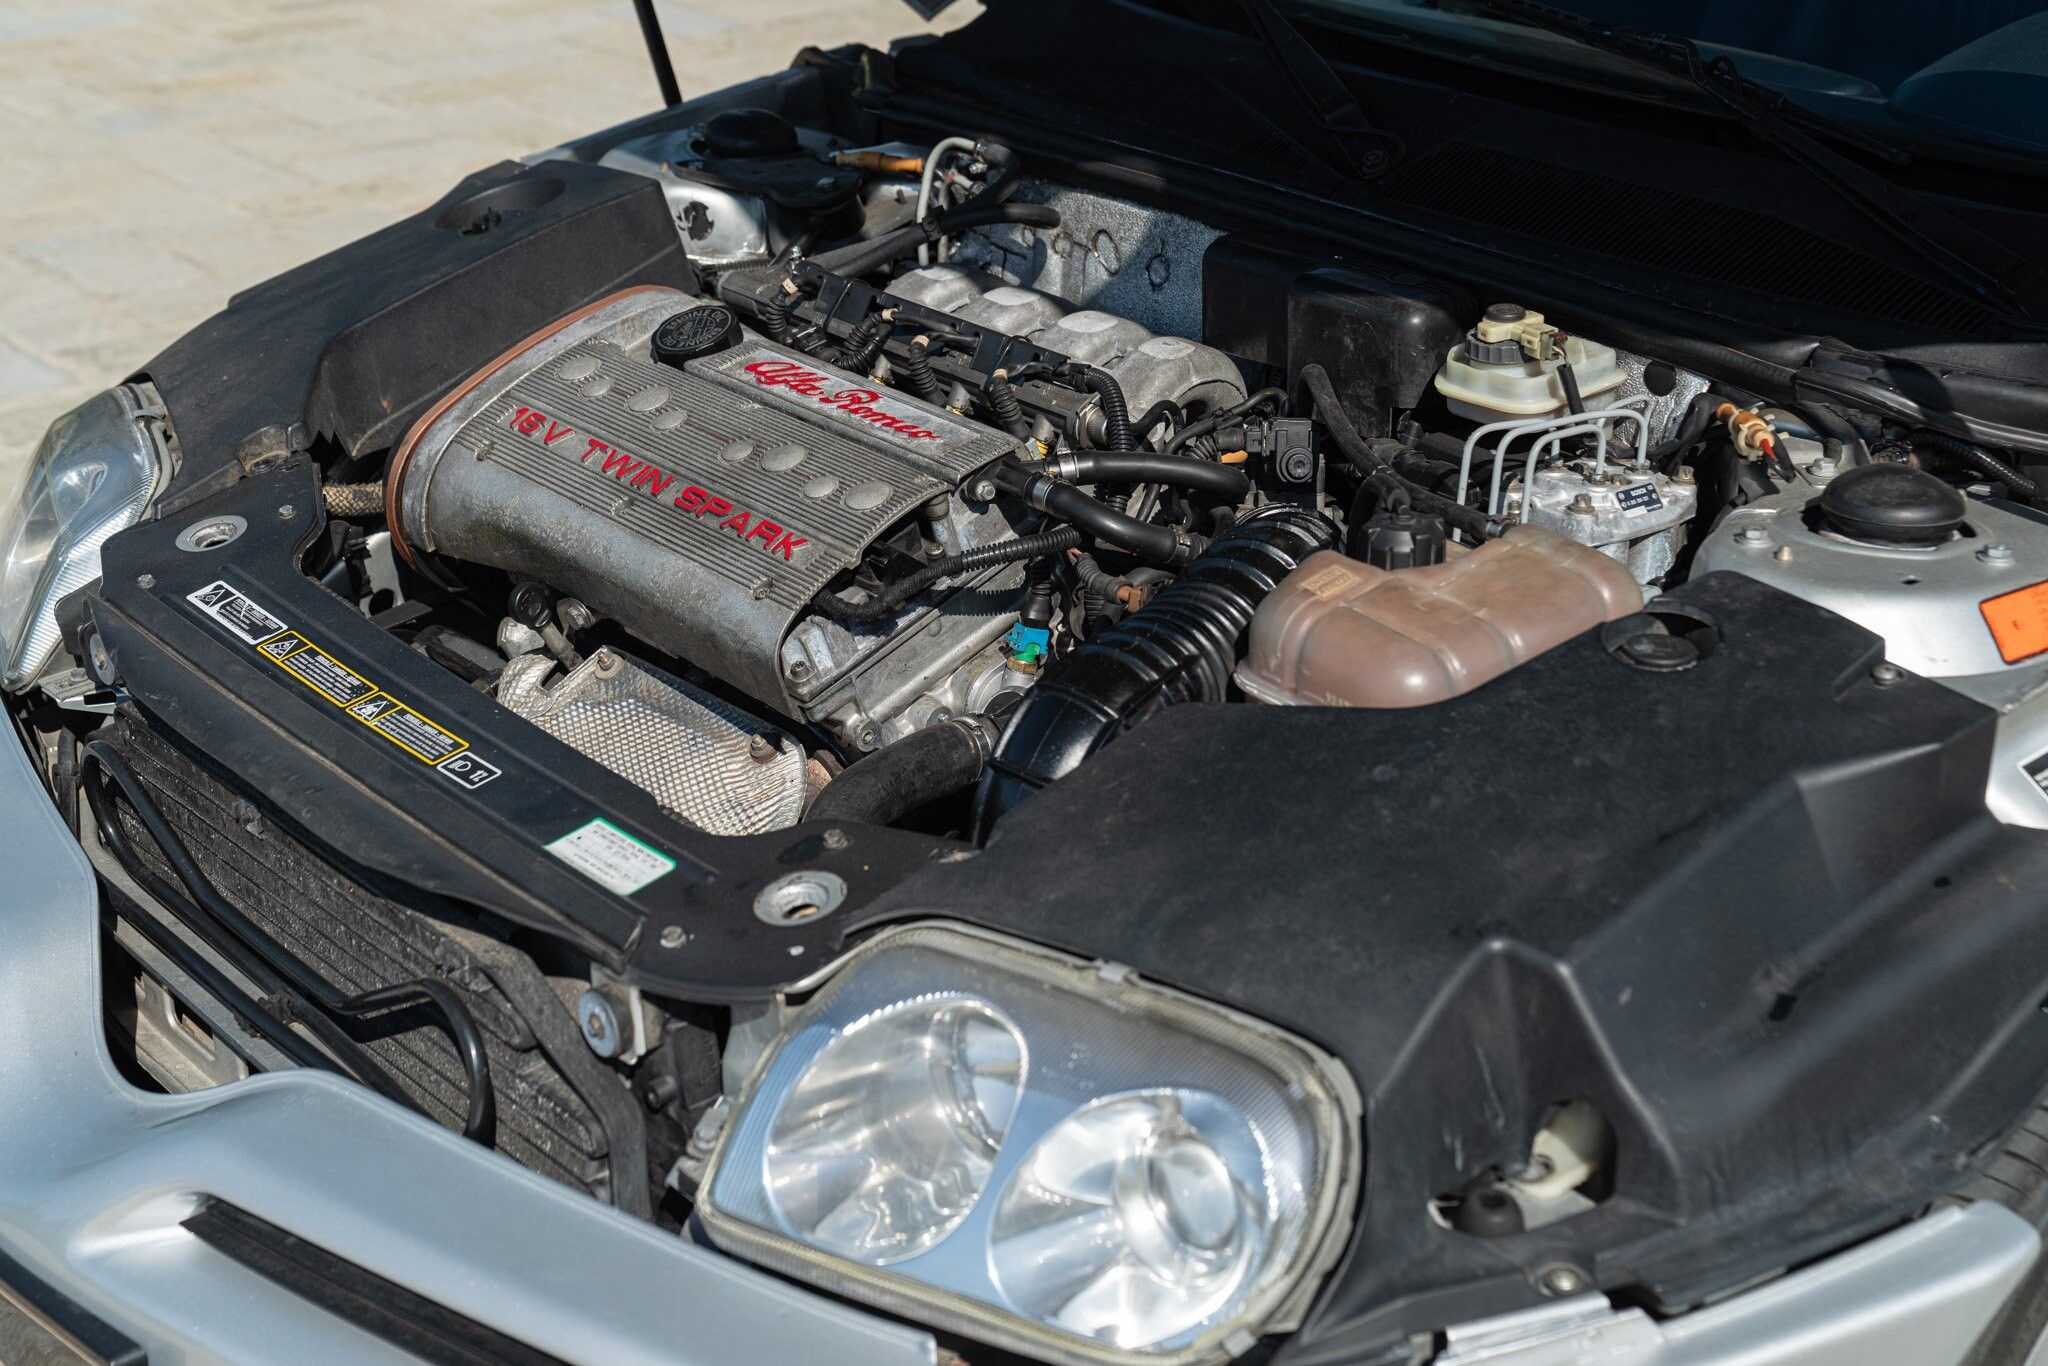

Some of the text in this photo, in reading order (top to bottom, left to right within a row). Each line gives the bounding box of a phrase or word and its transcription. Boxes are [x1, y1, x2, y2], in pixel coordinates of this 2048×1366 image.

[663, 327, 722, 347] ENGINE OIL
[666, 309, 726, 330] ENGINE OIL
[744, 361, 943, 439] Alfa Romeo
[510, 406, 810, 561] 16V TWIN SPARK
